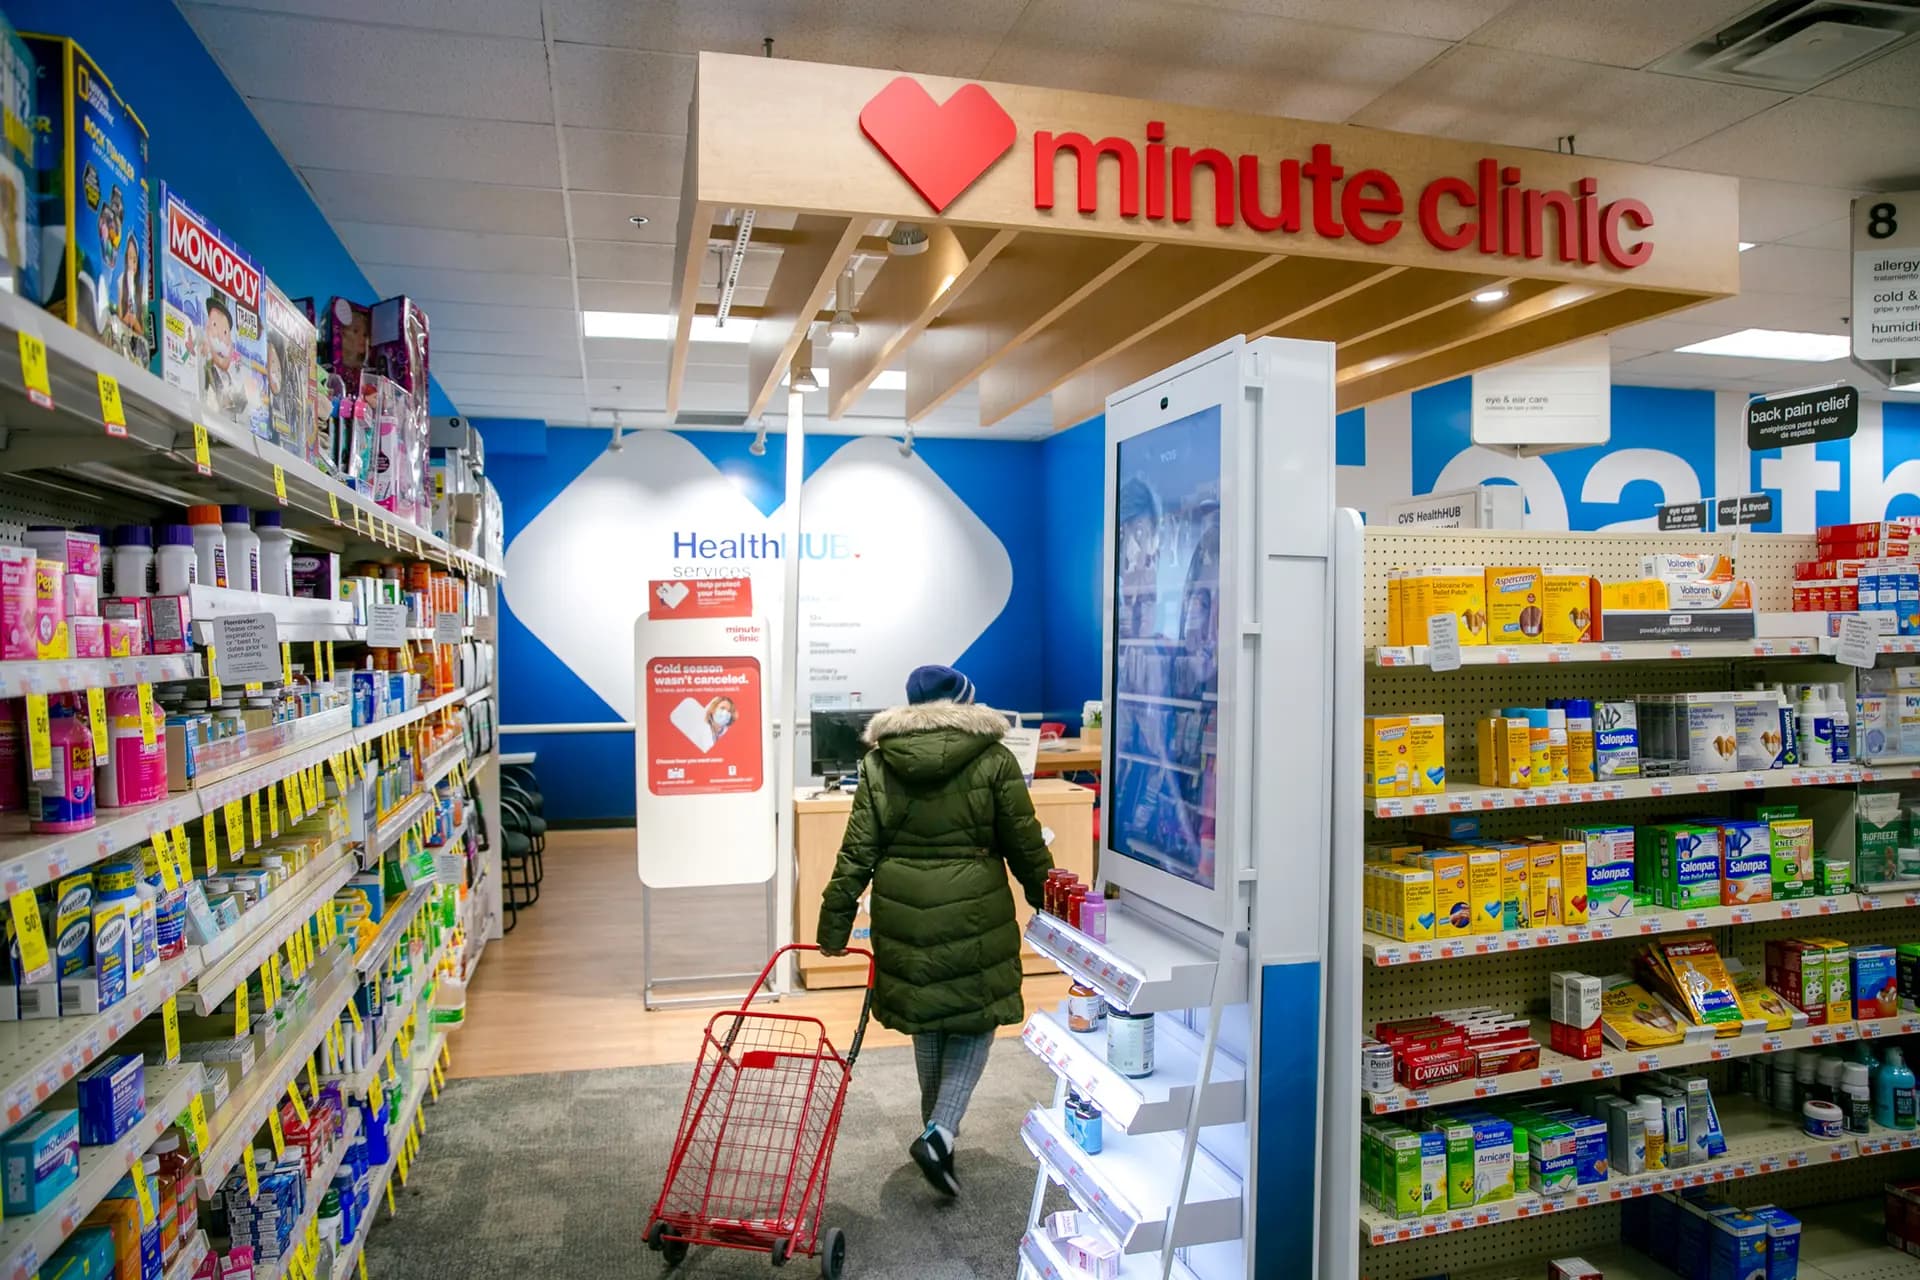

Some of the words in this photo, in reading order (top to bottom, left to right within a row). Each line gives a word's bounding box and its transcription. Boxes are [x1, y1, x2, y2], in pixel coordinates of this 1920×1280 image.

[1034, 121, 1403, 245] minute
[1418, 158, 1654, 269] clinic
[1868, 202, 1898, 239] 8
[171, 219, 258, 307] MONOPOLY
[1873, 260, 1920, 275] allergy
[1873, 290, 1904, 304] cold
[1908, 289, 1920, 302] &
[1751, 407, 1781, 424] back
[1784, 402, 1812, 421] pain
[1816, 393, 1850, 413] relief
[1820, 416, 1839, 426] dolor
[1398, 512, 1414, 525] CVS
[1417, 505, 1462, 522] HealthHUB
[1667, 559, 1696, 568] Voltaren
[673, 565, 752, 579] services
[1495, 573, 1537, 586] Aspercreme
[1680, 585, 1710, 595] Voltaren
[726, 625, 760, 634] minute
[733, 634, 760, 643] clinic
[654, 664, 682, 674] Cold
[682, 664, 723, 674] season
[654, 675, 692, 686] wasn't
[694, 674, 749, 685] canceled.
[1600, 733, 1634, 746] Salonpas
[1862, 830, 1898, 842] BIOFREEZE
[1775, 840, 1794, 848] KNEE
[1680, 860, 1716, 874] Salonpas
[1730, 860, 1768, 873] Salonpas
[1592, 867, 1630, 881] Salonpas
[1414, 1063, 1459, 1081] CAPZASIN
[39, 1126, 76, 1160] Imodium
[1478, 1152, 1510, 1162] Arnicare
[1546, 1158, 1574, 1170] Salonpas
